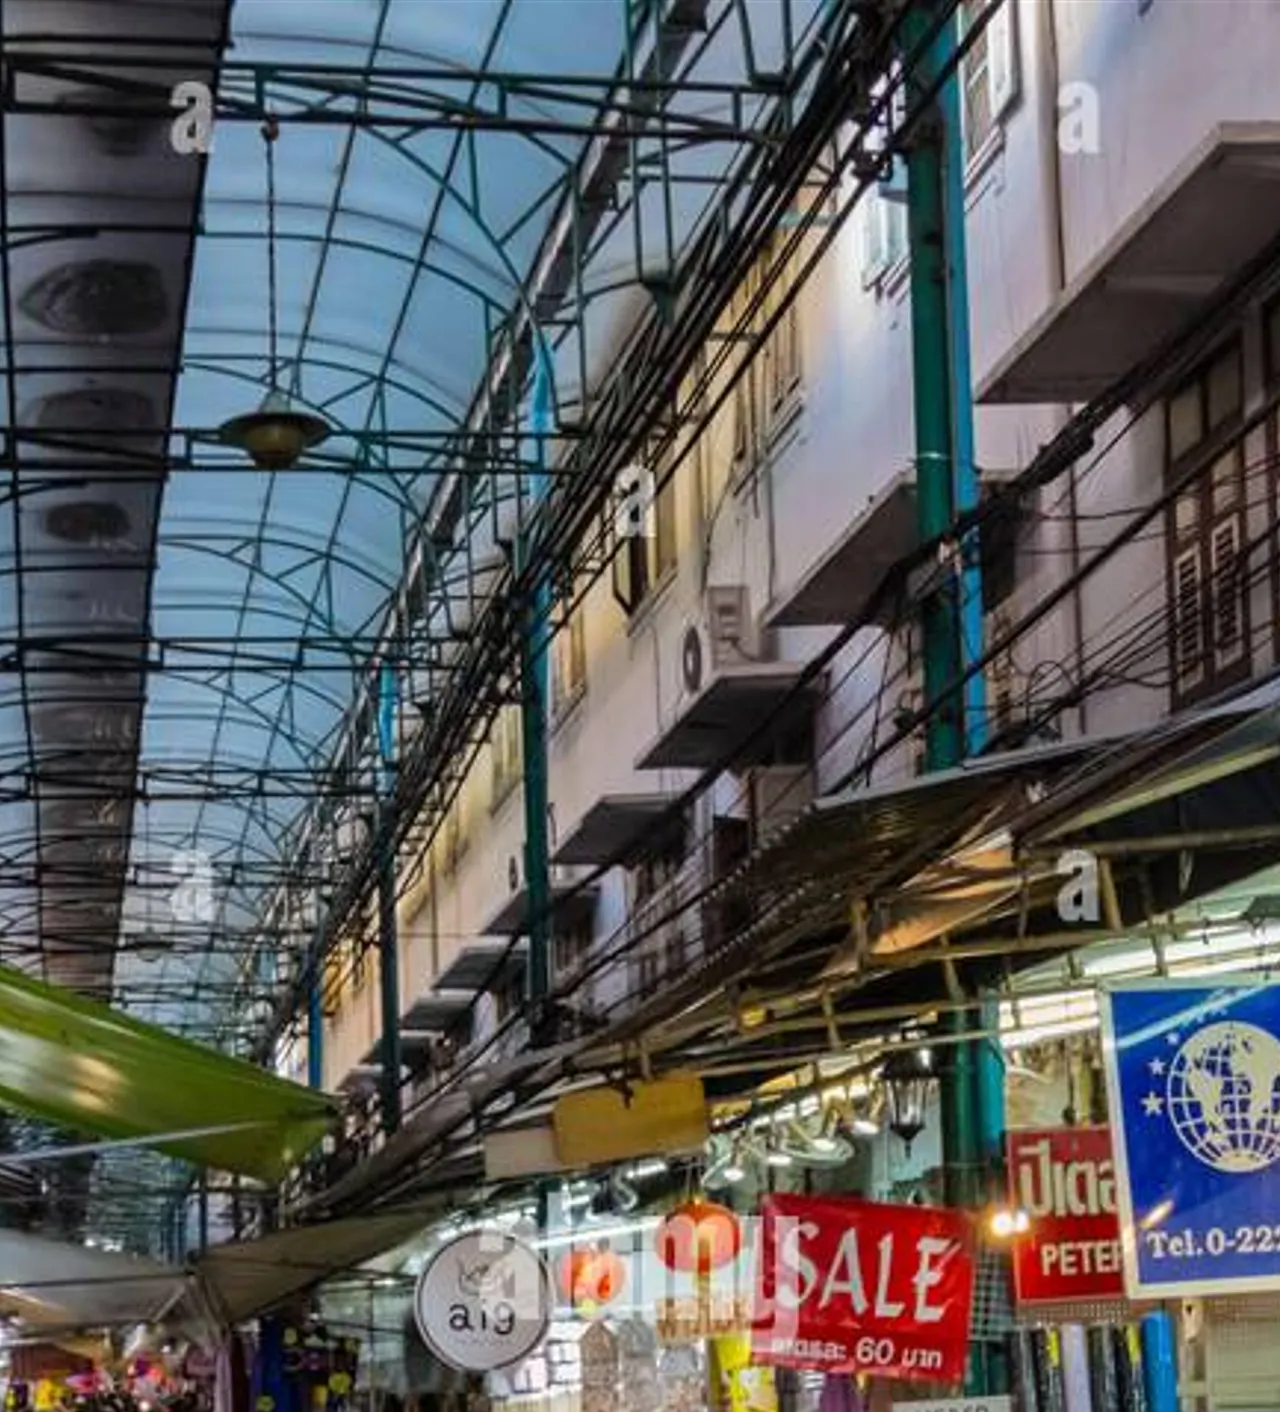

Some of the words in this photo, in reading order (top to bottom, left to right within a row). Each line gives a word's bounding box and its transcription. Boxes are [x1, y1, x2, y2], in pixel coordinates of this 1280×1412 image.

[775, 1220, 963, 1323] SALE
[855, 1336, 894, 1364] 60
[901, 1347, 942, 1369] บาท
